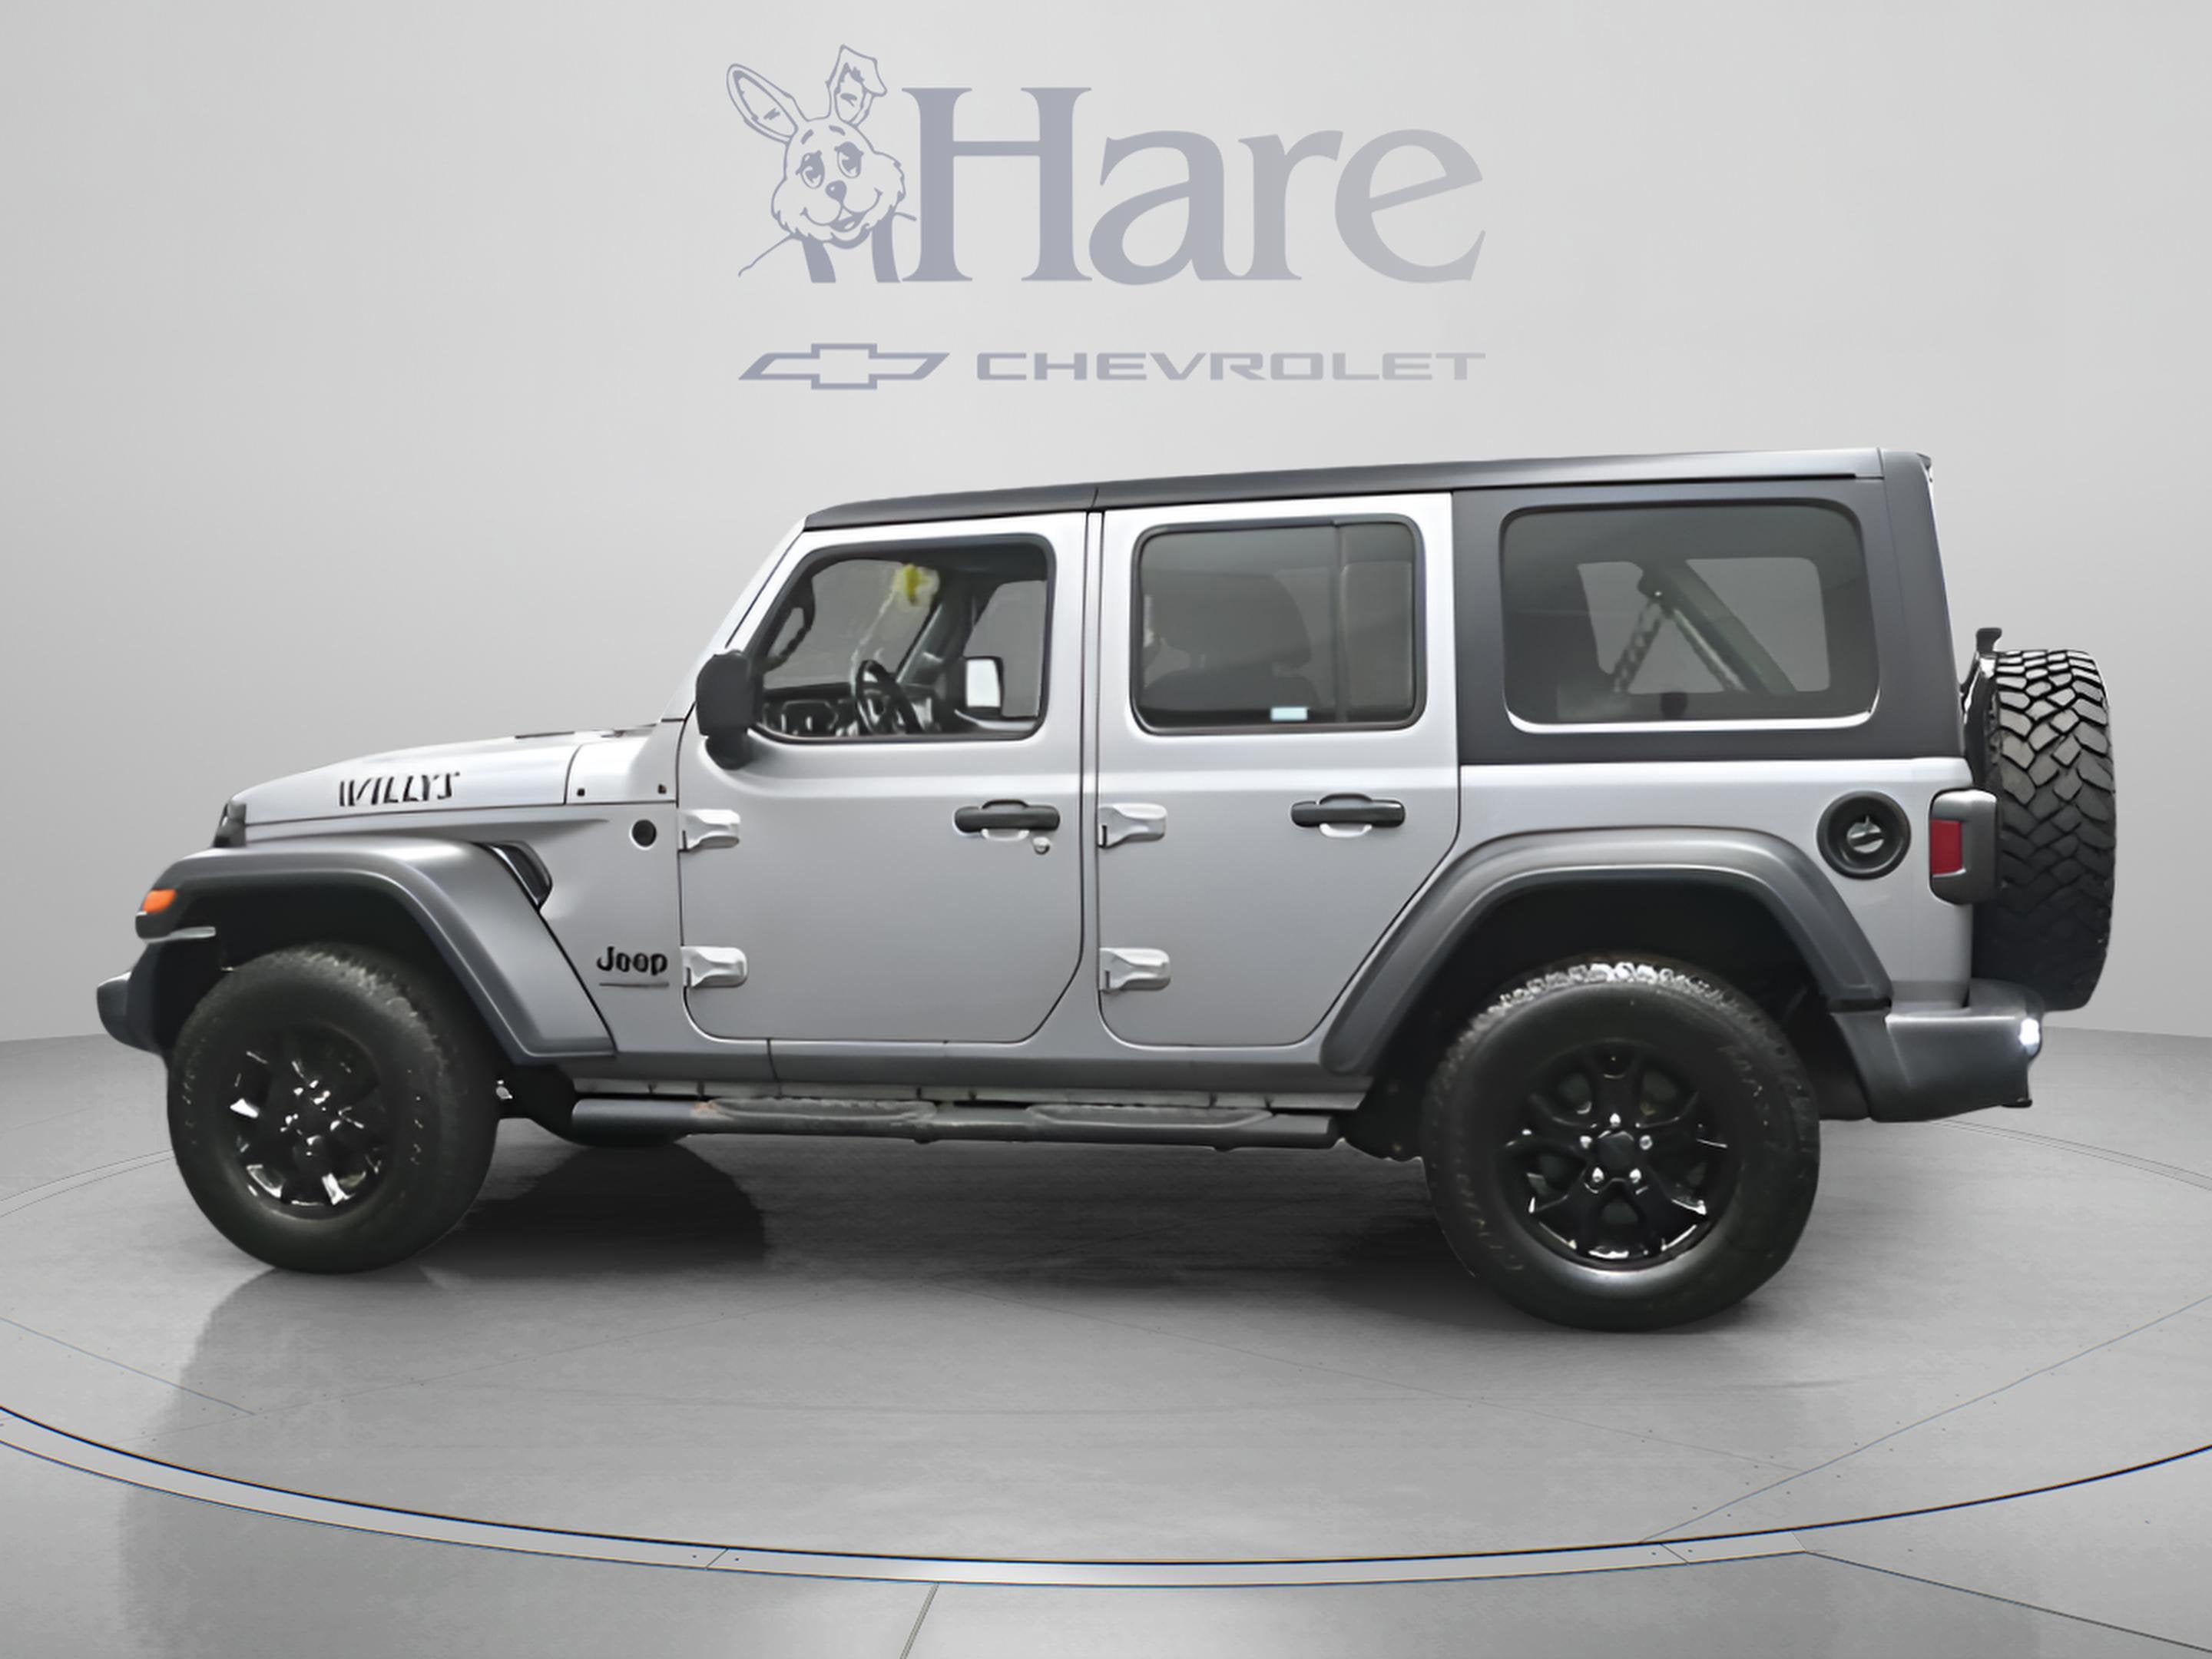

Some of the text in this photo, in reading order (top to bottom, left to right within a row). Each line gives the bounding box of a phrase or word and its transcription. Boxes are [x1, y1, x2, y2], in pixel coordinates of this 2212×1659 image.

[902, 87, 1486, 285] Hare
[976, 352, 1486, 381] CHEVROLET
[339, 771, 460, 807] WILLYS
